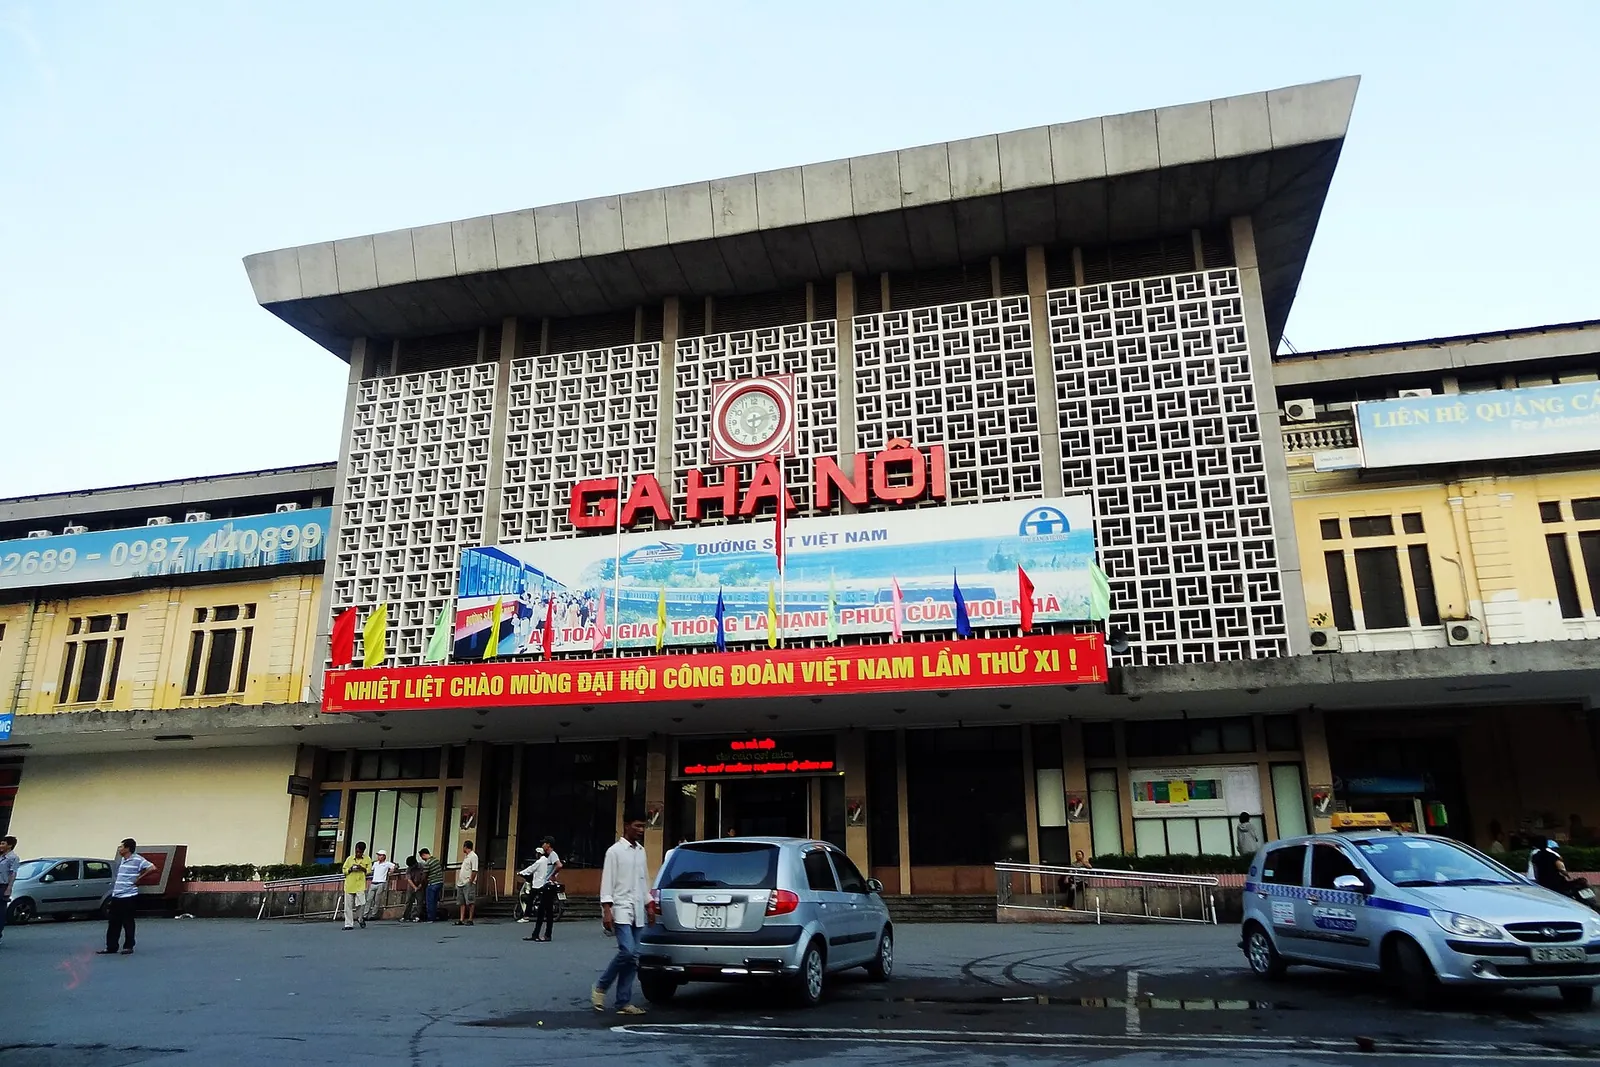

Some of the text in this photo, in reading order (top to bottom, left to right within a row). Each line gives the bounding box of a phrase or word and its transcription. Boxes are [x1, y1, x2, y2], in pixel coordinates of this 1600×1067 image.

[1372, 406, 1430, 428] LIÊN
[1435, 401, 1469, 424] HỆ
[568, 436, 948, 532] GA HÀ NỘI
[0, 547, 77, 578] 2689
[110, 536, 190, 567] 0987
[200, 522, 322, 558] 440899
[696, 529, 888, 555] ĐƯỜNG ST VIỆT NAM
[907, 597, 952, 621] CỦA
[964, 600, 1003, 619] MỌI
[344, 646, 1077, 703] NHIỆT LIỆT CHÀO MỪNG ĐẠI HỘI CÔNG ĐOÀN VIỆT NAM LẦN THỨ XI !
[700, 916, 722, 928] 7790
